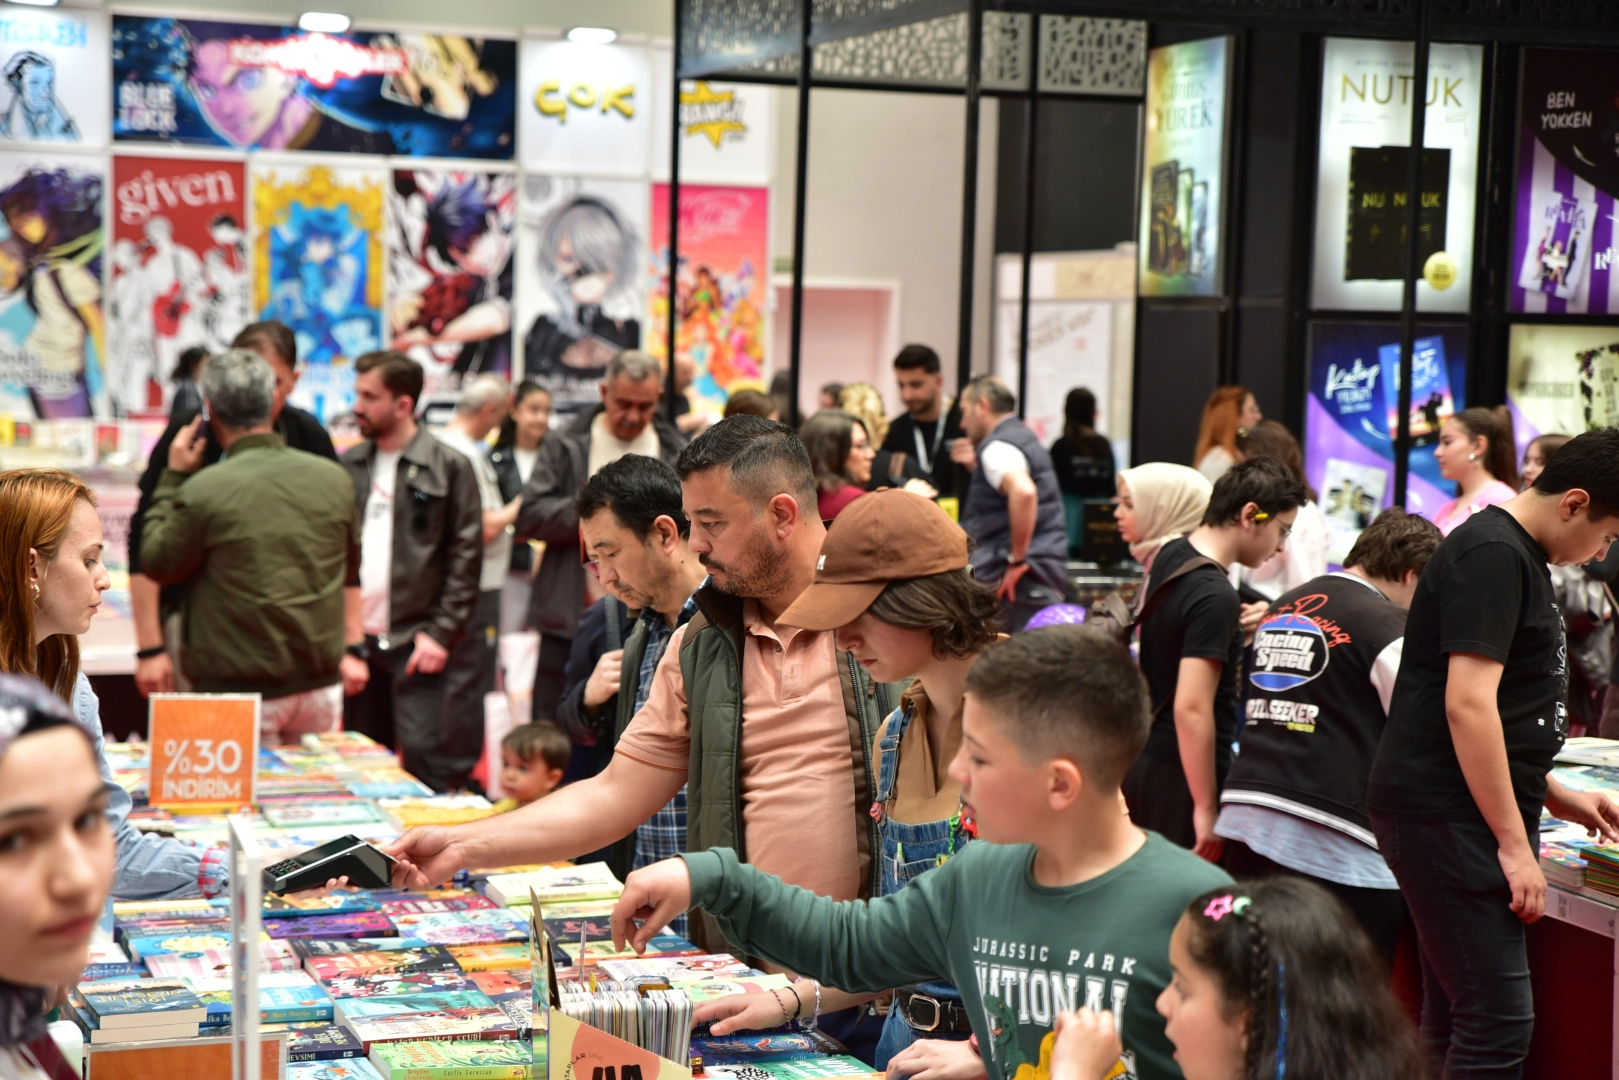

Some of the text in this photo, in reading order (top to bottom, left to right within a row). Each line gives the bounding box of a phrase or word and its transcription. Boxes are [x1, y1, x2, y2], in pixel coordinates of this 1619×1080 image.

[119, 81, 174, 109] BLUE
[535, 80, 635, 123] ÇOK
[1546, 91, 1576, 109] BEN
[118, 107, 178, 132] LOCK
[1540, 110, 1593, 130] YOKKEN
[116, 169, 237, 225] given
[1255, 647, 1316, 672] Speed
[164, 739, 242, 774] %30
[163, 775, 242, 799] İNDİRİM
[973, 936, 1138, 976] JURASSIC PARK
